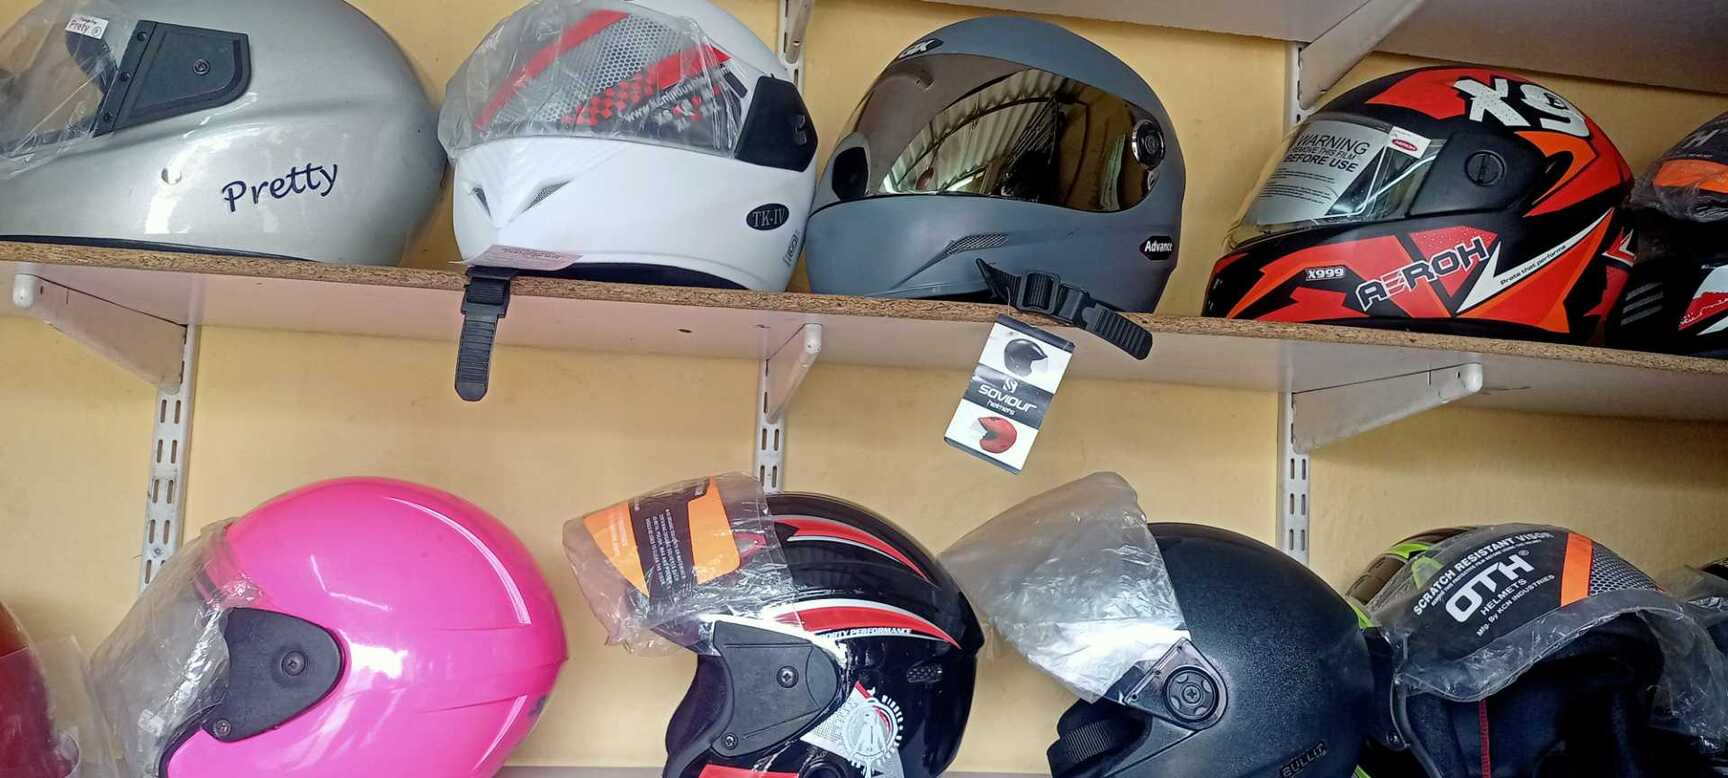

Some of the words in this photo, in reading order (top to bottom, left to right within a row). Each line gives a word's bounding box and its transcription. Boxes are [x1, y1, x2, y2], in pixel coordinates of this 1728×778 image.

[1284, 153, 1329, 166] BEFORE
[1329, 157, 1358, 173] USE
[1296, 134, 1370, 155] WARNING
[1335, 150, 1358, 160] FILM
[221, 162, 338, 212] Pretty
[1308, 268, 1345, 279] X999
[1413, 568, 1456, 616] SCRATCH
[1454, 537, 1514, 573] RESISTANT
[1445, 553, 1535, 623] OTH
[1480, 578, 1527, 616] HELMETS
[1488, 613, 1499, 623] By
[1511, 574, 1556, 602] INDUSTRIES
